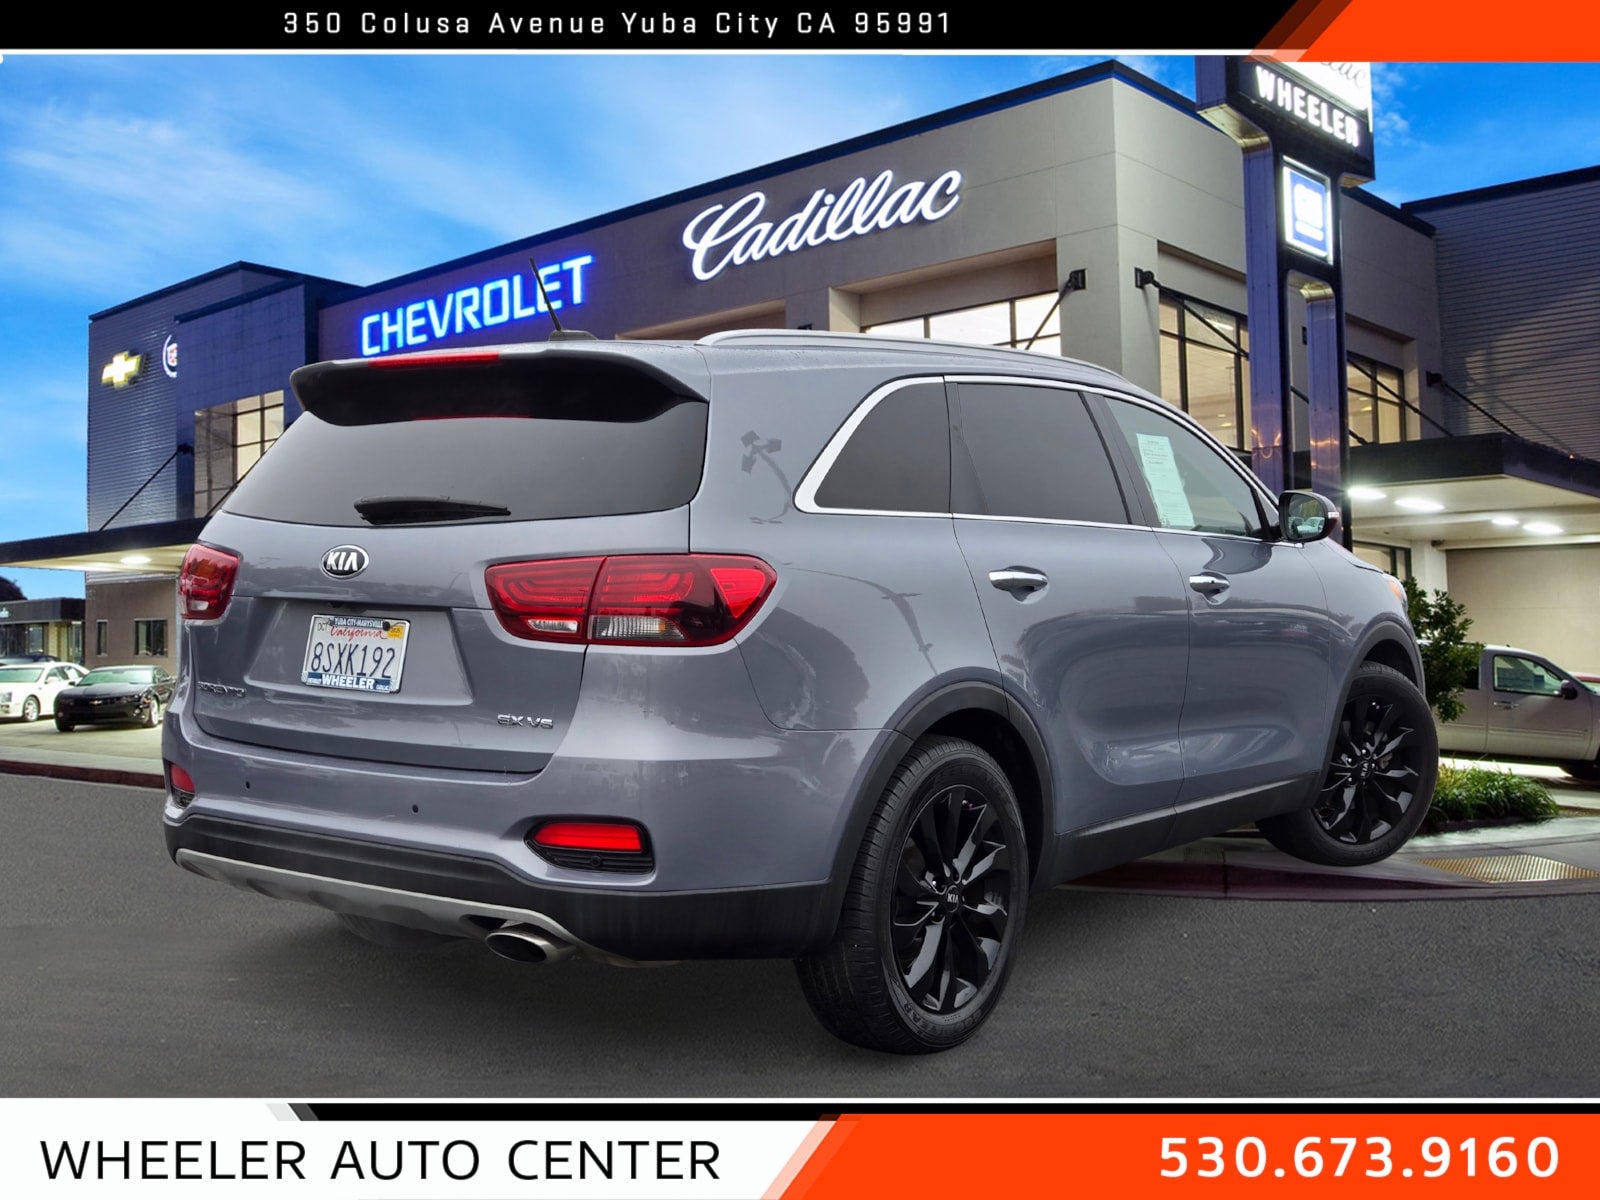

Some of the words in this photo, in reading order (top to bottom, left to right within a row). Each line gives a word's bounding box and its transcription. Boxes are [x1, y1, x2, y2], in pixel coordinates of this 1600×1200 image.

[1255, 65, 1361, 148] WHEELER
[682, 169, 962, 281] Cadillac
[361, 254, 593, 357] CHEVROLET
[326, 551, 358, 571] KIA
[330, 625, 388, 641] California
[311, 642, 395, 678] 8SXK192
[321, 674, 375, 689] WHEELER
